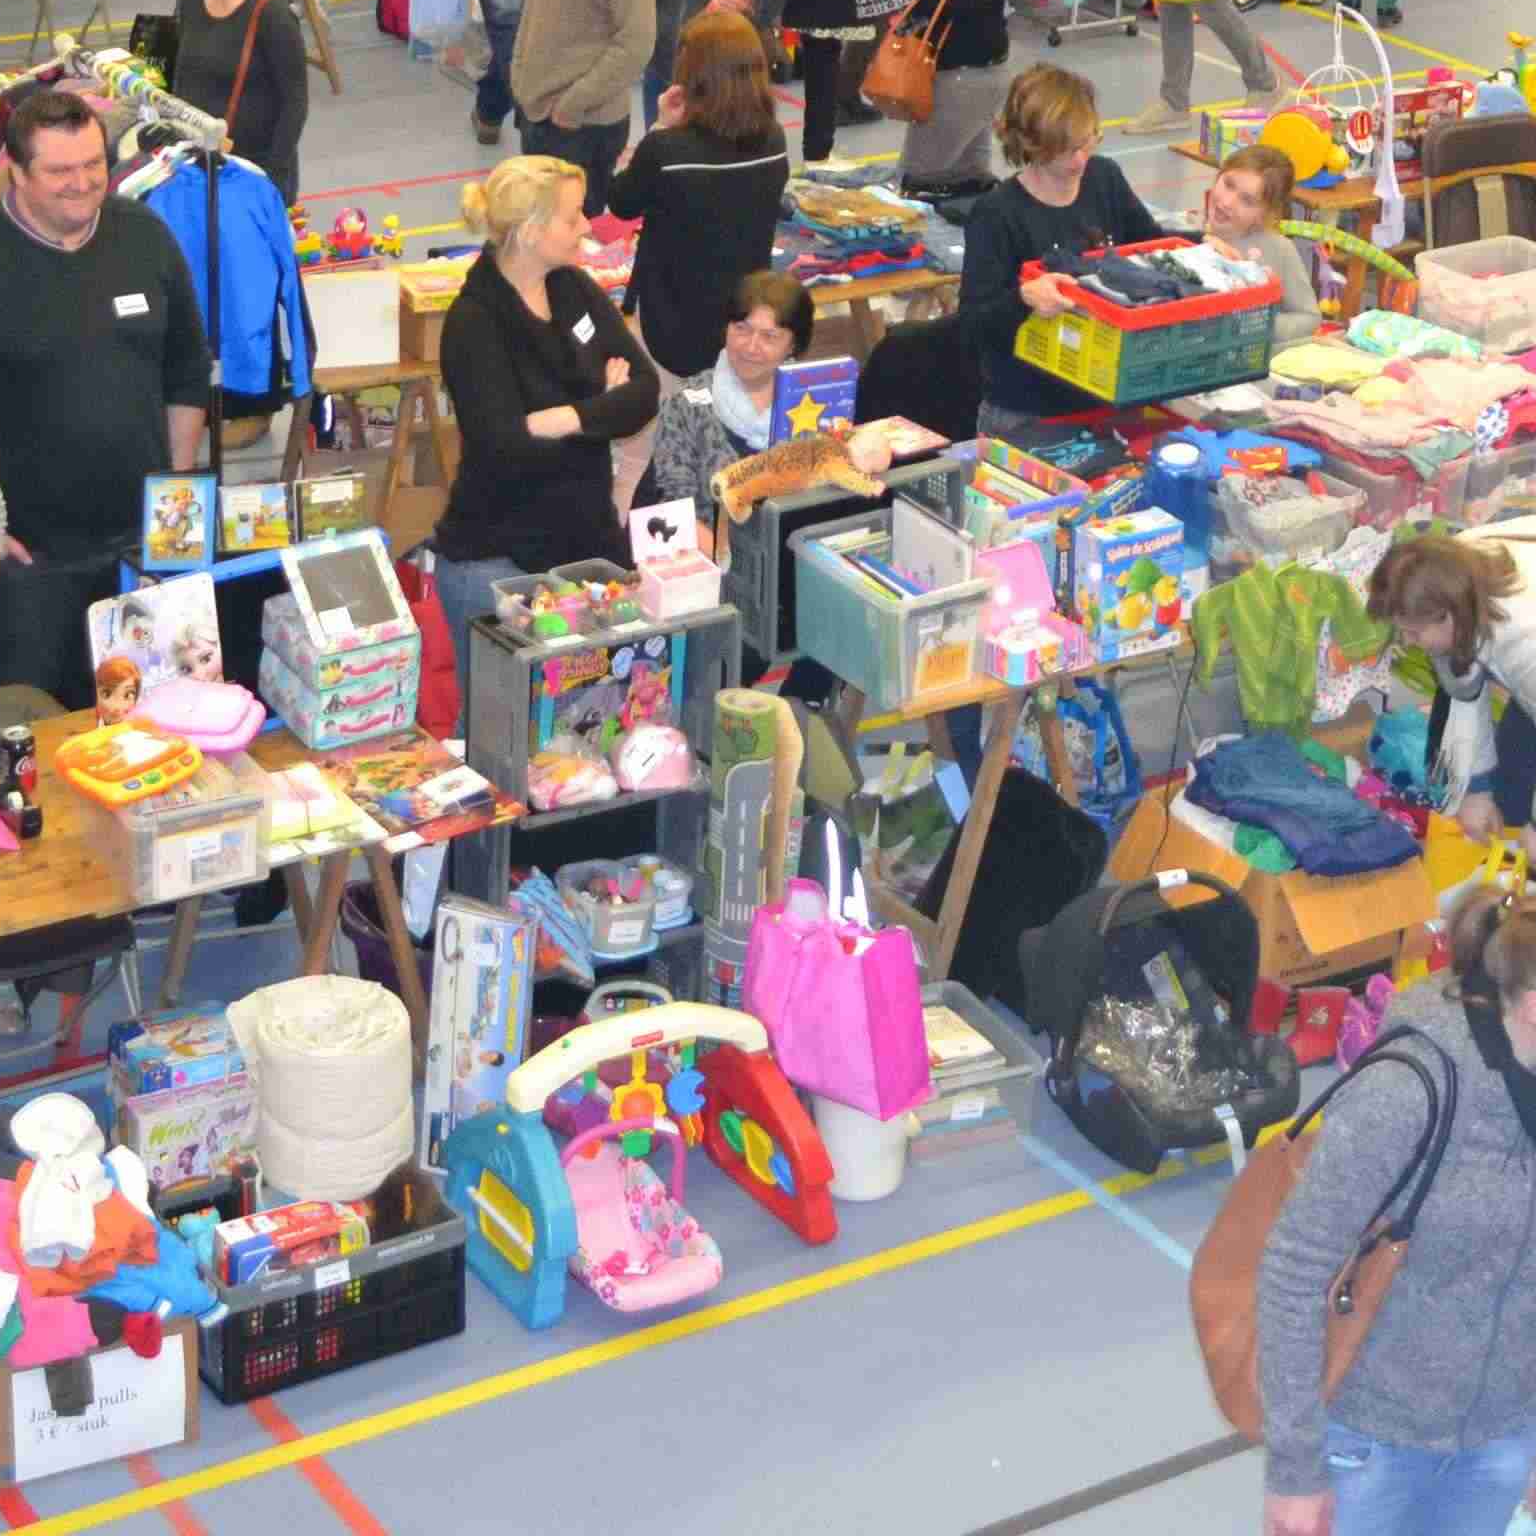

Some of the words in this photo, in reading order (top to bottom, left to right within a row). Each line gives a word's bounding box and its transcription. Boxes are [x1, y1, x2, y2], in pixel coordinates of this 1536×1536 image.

[97, 1386, 139, 1409] pulls
[35, 1427, 45, 1443] 3
[75, 1414, 111, 1434] stuk
